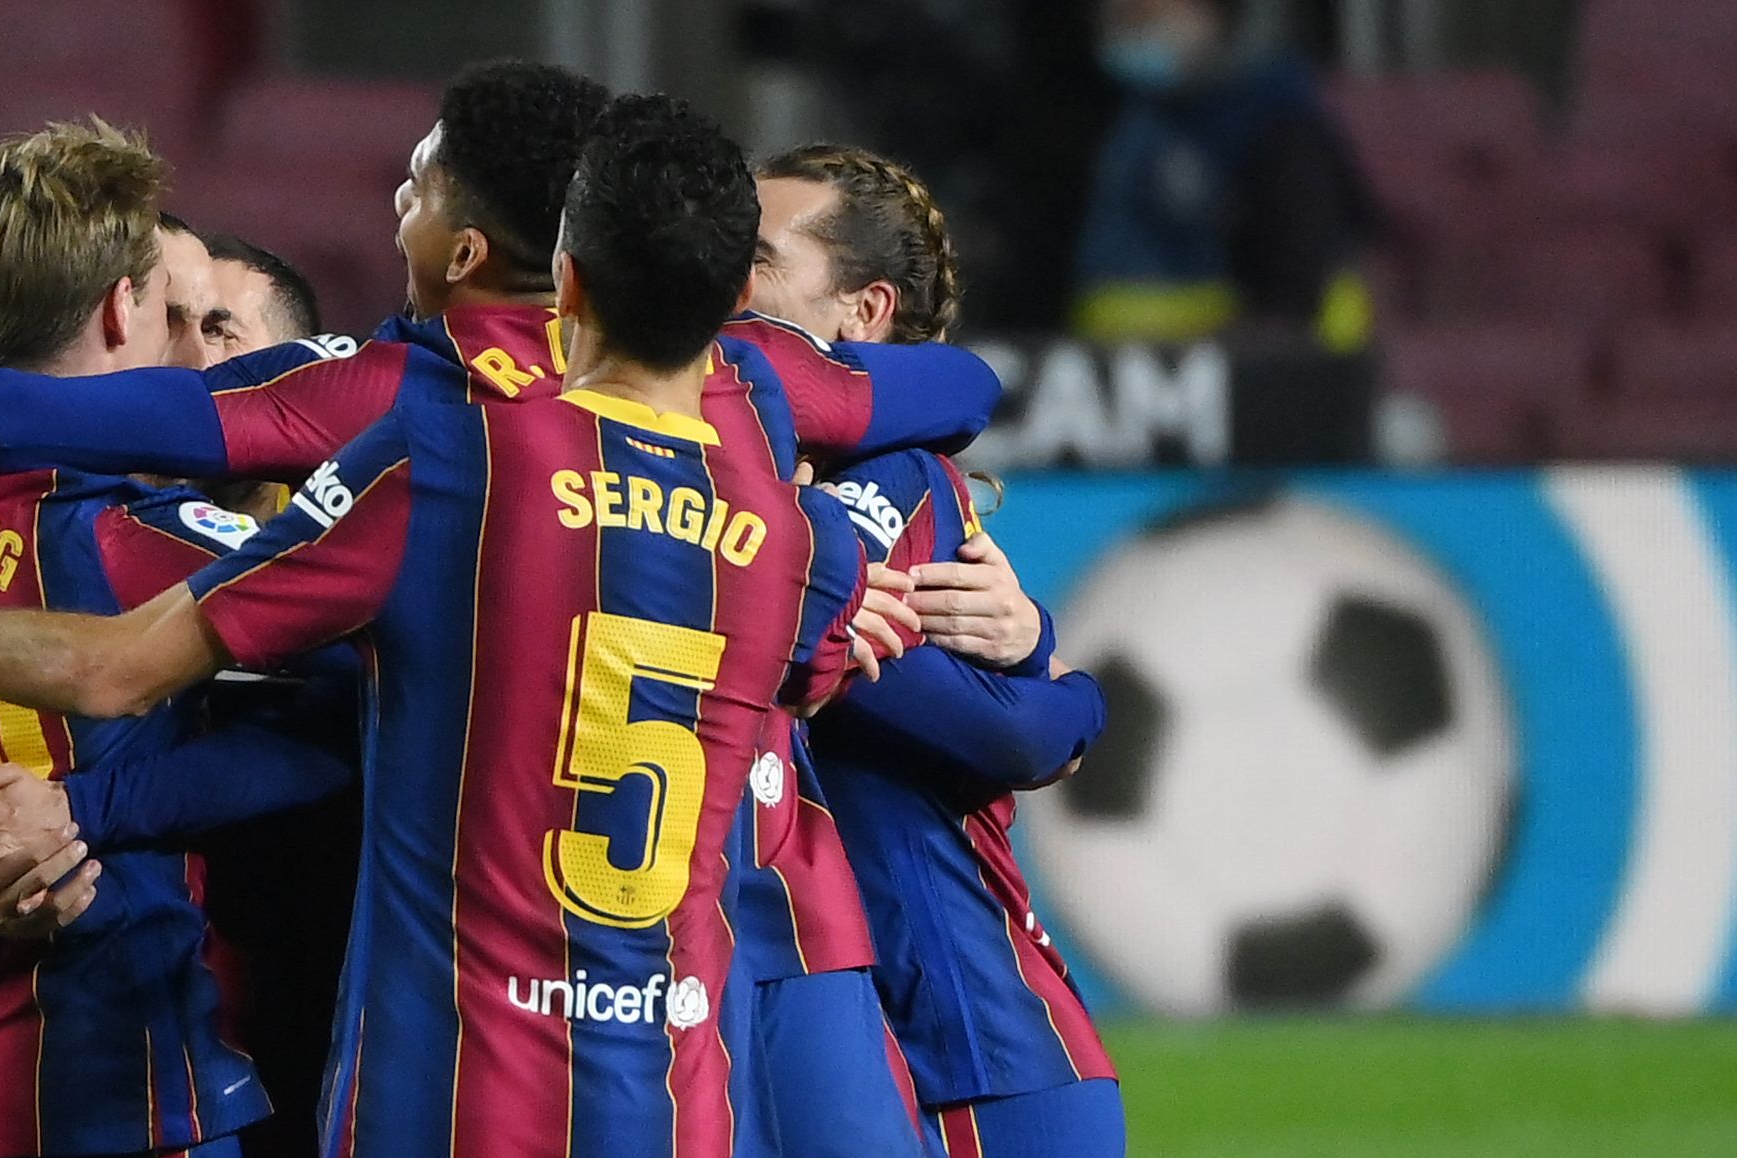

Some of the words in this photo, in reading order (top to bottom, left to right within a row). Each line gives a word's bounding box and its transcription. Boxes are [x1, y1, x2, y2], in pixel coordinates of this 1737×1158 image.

[550, 469, 767, 567] SERGIO
[836, 481, 903, 540] eko
[543, 611, 726, 928] 5
[508, 969, 666, 1024] unicef
